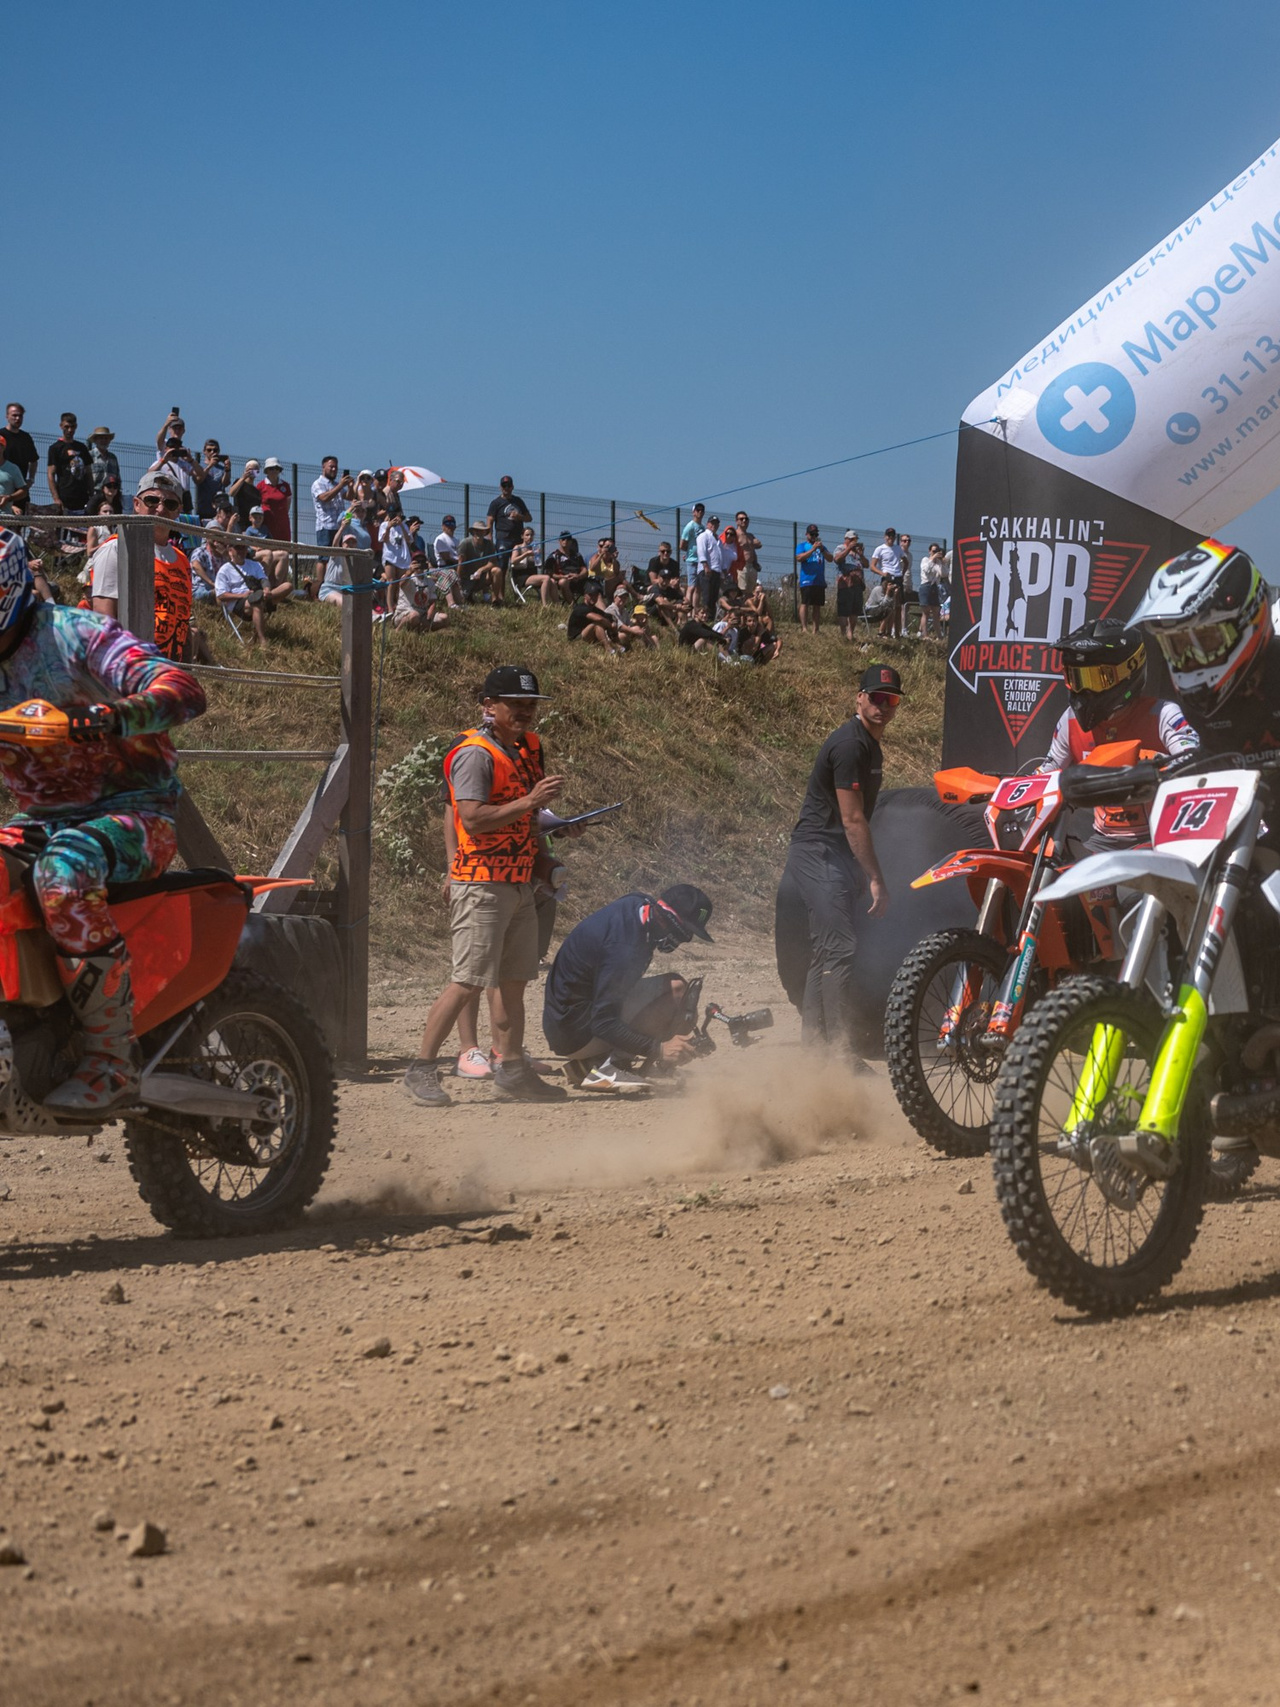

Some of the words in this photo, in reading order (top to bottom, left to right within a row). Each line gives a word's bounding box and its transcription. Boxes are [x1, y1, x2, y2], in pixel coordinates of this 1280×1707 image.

[996, 215, 1204, 396] Медицинский
[989, 517, 1091, 542] SAKHALIN
[978, 540, 1092, 640] NPR
[959, 644, 975, 671] NO
[979, 644, 1034, 672] PLACE
[1003, 679, 1041, 692] EXTREME
[1004, 692, 1037, 702] ENDURO
[1007, 701, 1032, 712] RALLY
[1007, 782, 1033, 803] 5
[1169, 799, 1217, 833] 14
